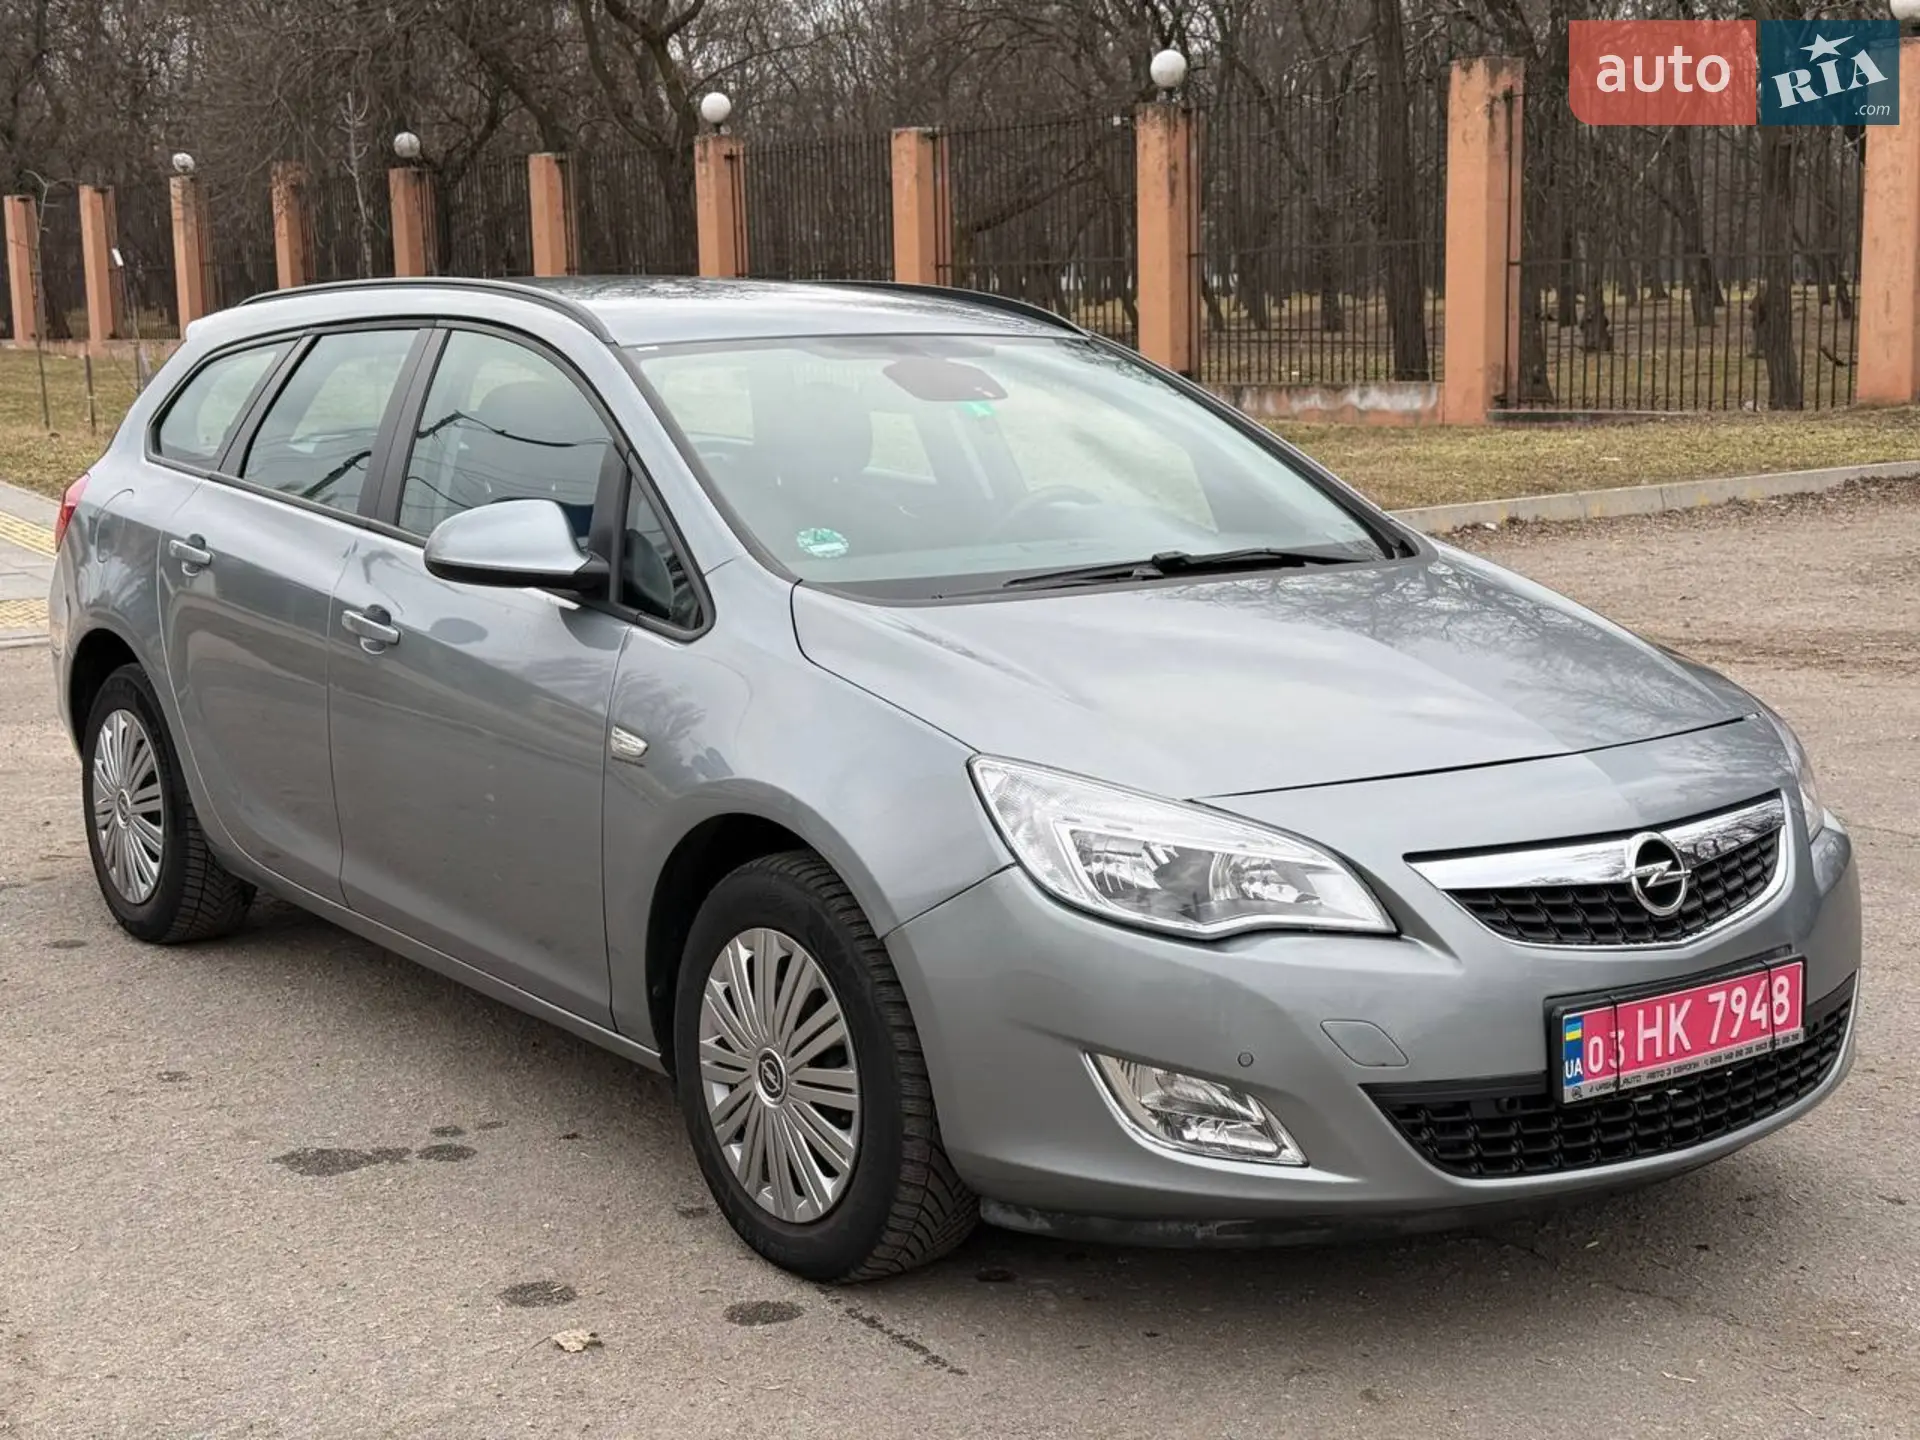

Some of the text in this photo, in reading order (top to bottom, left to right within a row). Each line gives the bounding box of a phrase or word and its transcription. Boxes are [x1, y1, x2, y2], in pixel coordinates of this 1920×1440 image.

[1587, 1030, 1625, 1074] 03
[1637, 999, 1692, 1062] HK
[1707, 975, 1791, 1045] 7948
[1565, 1057, 1584, 1079] UA
